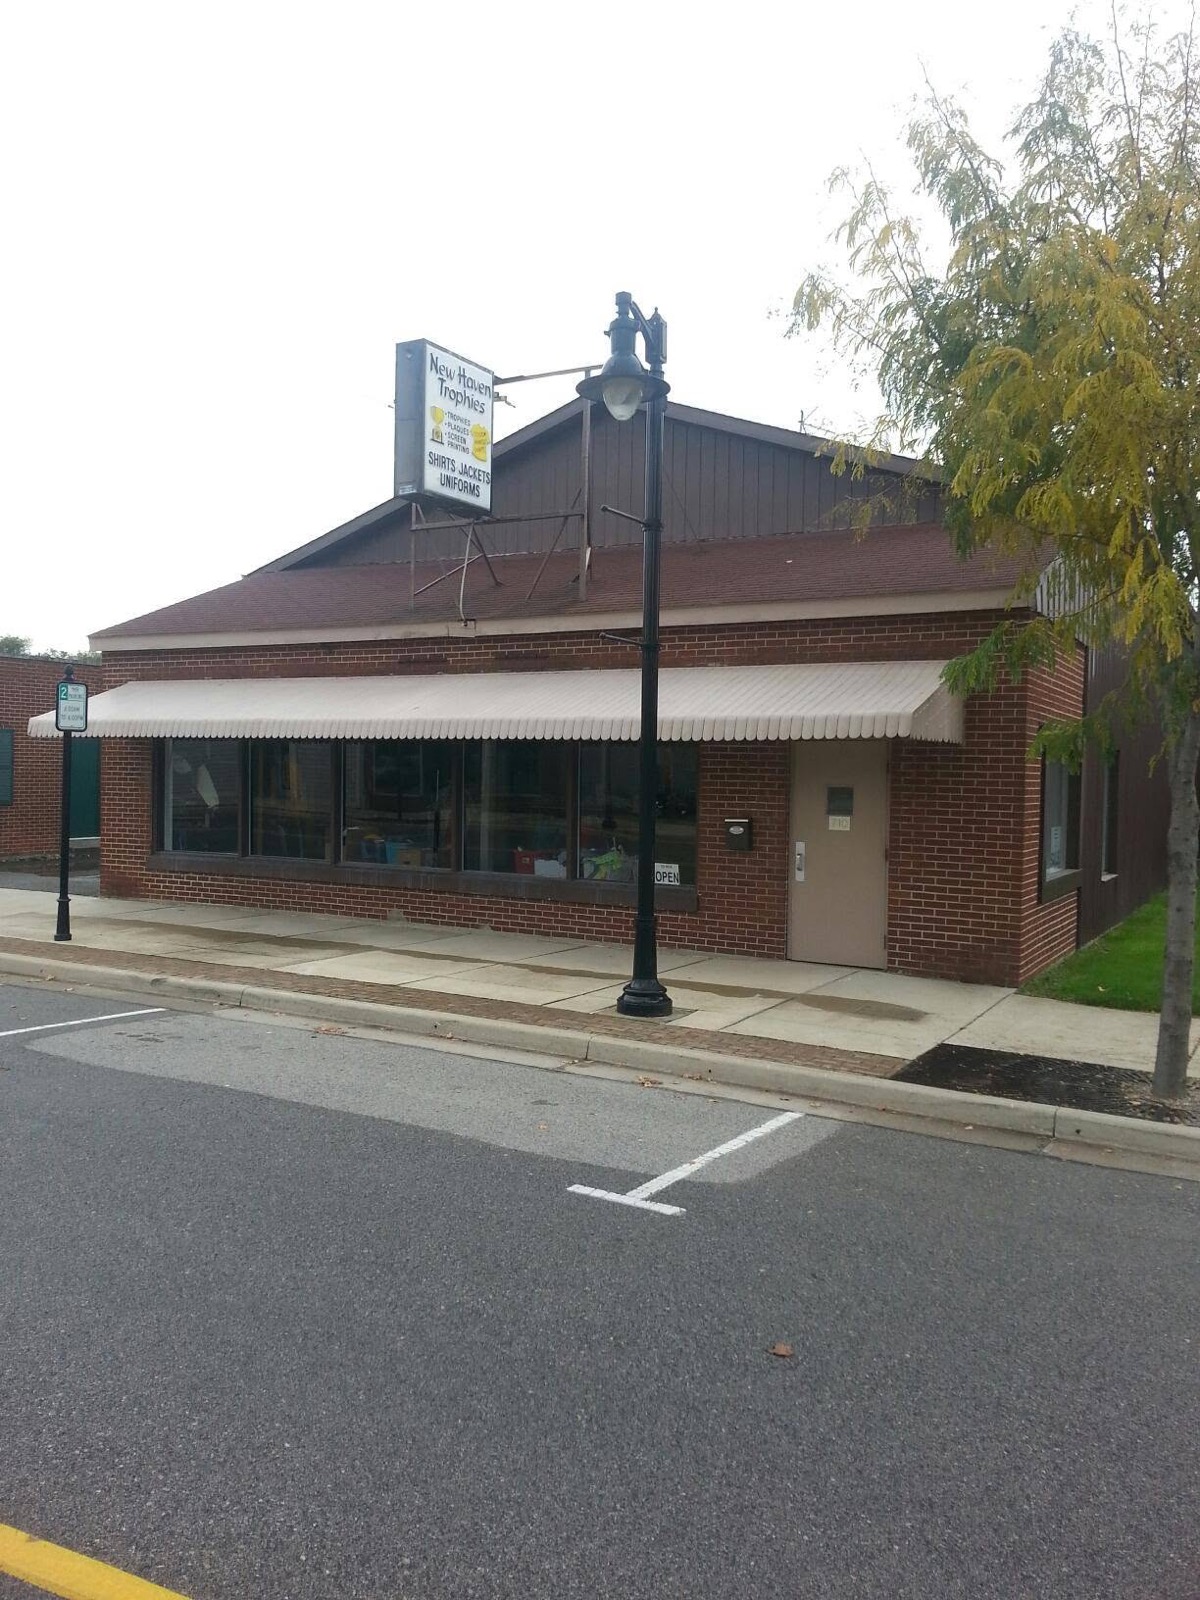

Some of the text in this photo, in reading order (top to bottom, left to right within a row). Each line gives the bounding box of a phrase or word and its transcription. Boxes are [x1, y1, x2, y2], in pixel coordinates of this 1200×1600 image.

[430, 353, 491, 399] New Haven
[438, 377, 485, 414] Trophies
[447, 411, 470, 427] TROPHIES
[447, 421, 470, 436] PLAQUES
[447, 431, 467, 445] SCREEN
[447, 441, 470, 455] PRINTING
[428, 451, 491, 484] SHIRTS JACKETS
[440, 472, 480, 498] UNIFORMS
[61, 687, 67, 698] 2
[655, 871, 679, 884] OPEN
